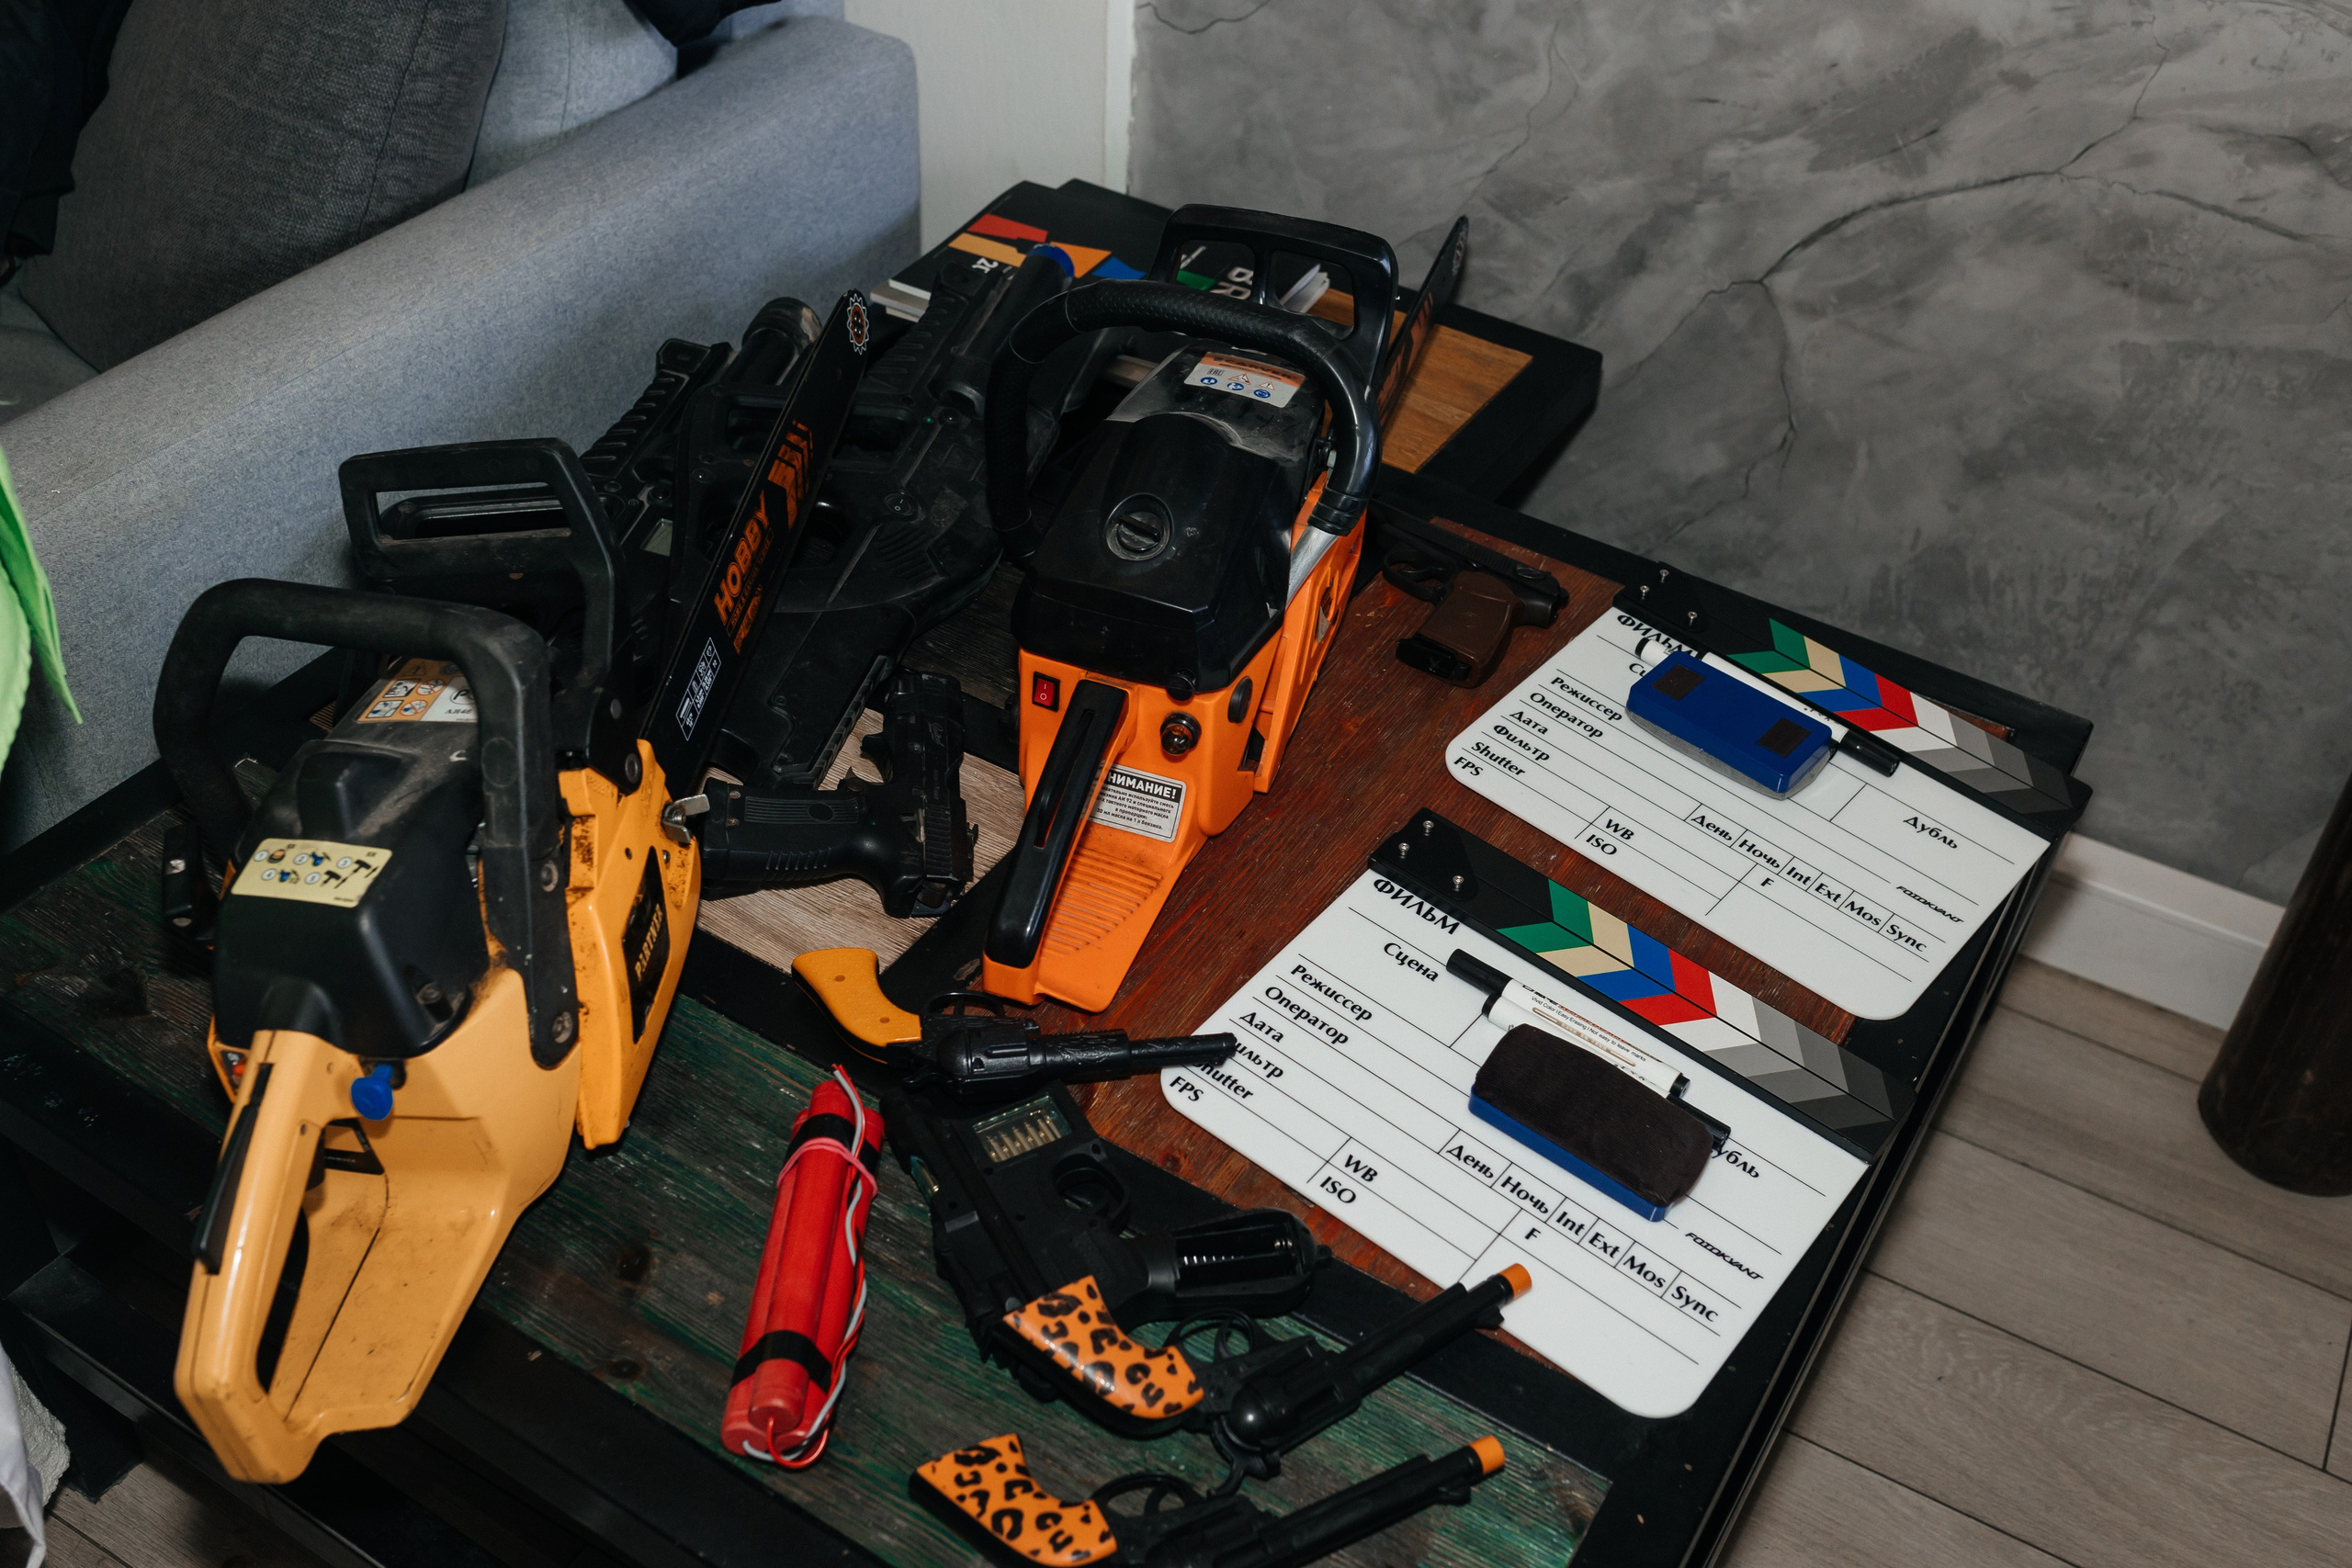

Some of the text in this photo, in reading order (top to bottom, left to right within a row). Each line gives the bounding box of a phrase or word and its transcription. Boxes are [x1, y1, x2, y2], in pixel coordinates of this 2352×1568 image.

[714, 490, 769, 626] HOBBY
[1550, 676, 1623, 722] Режиссер
[1509, 710, 1548, 735] Дата
[1530, 692, 1604, 739] Оператор
[1493, 724, 1550, 761] Фильтр
[1453, 756, 1484, 776] FPS
[1471, 741, 1526, 776] Shutter
[1108, 773, 1177, 799] НИМАНИЕ!
[1128, 793, 1159, 805] используйте
[1105, 799, 1127, 808] тактного
[1127, 805, 1154, 816] моторного
[1111, 812, 1126, 820] масла
[1141, 819, 1163, 829] бензина.
[1136, 801, 1171, 814] специального
[1605, 818, 1634, 840] WB
[1690, 815, 1733, 841] День
[1903, 816, 1958, 850] Дубль
[1586, 833, 1618, 855] ISO
[1738, 839, 1781, 869] Ночь
[1760, 877, 1774, 887] F
[1786, 866, 1812, 886] Int
[1374, 878, 1461, 935] ФИЛЬМ
[1815, 883, 1842, 903] Ext
[1844, 900, 1882, 927] Mos
[633, 902, 664, 982] PARTNER
[1886, 923, 1927, 953] Sync
[1383, 942, 1439, 982] Сцена
[1290, 964, 1373, 1021] Режиссер
[1238, 1011, 1284, 1043] Дата
[1265, 986, 1349, 1045] Оператор
[1532, 996, 1544, 1006] Vivid
[1544, 1002, 1555, 1012] Color
[1557, 1010, 1569, 1021] Easy
[1569, 1017, 1587, 1031] Erasing
[1589, 1026, 1599, 1035] Not
[1235, 1042, 1284, 1079] ильтр
[1170, 1076, 1204, 1102] FPS
[1193, 1063, 1254, 1099] hutter
[1344, 1155, 1378, 1182] WB
[1446, 1145, 1493, 1179] День
[1711, 1148, 1759, 1178] убль
[1319, 1176, 1357, 1203] ISO
[1500, 1176, 1549, 1214] Ночь
[1524, 1227, 1541, 1240] F
[1555, 1211, 1587, 1235] Int
[1589, 1232, 1621, 1258] Ext
[1623, 1255, 1667, 1288] Mos
[1671, 1285, 1719, 1322] Sync
